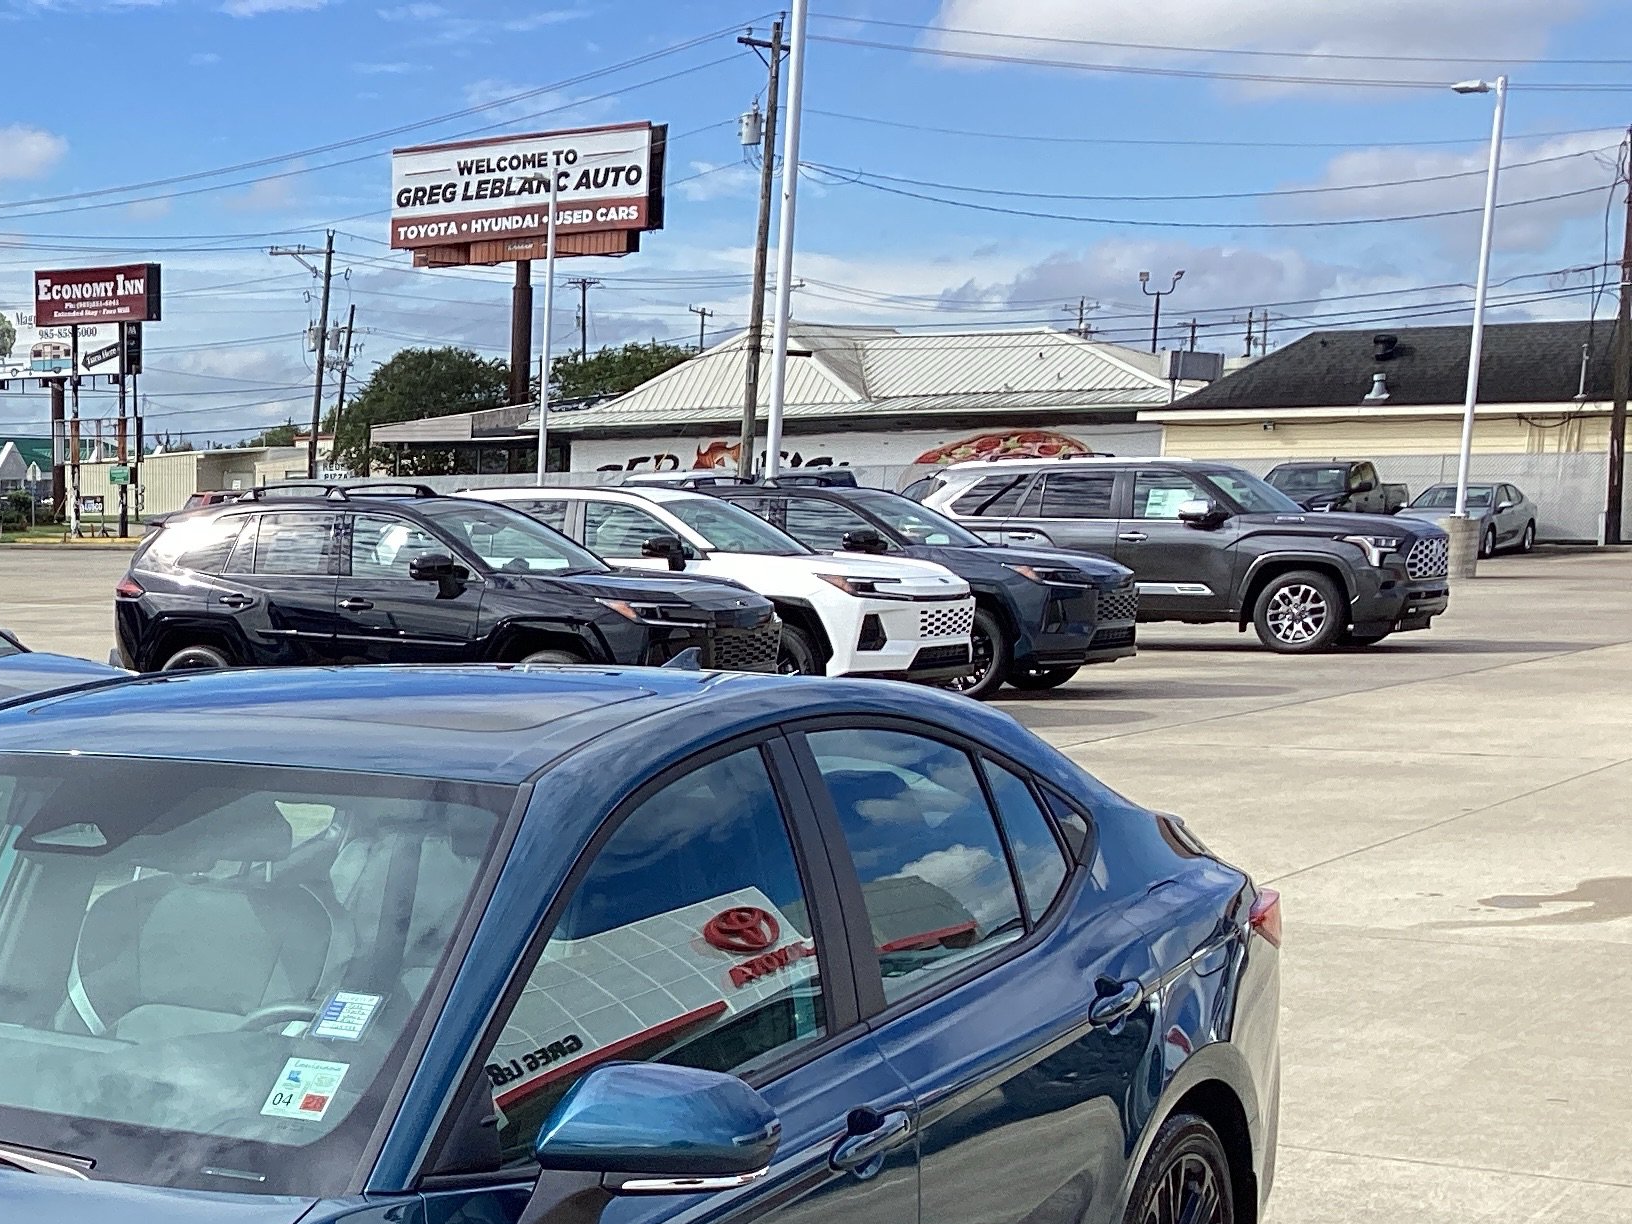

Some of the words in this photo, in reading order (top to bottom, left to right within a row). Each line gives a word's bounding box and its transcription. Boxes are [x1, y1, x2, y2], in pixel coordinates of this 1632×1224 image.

[457, 153, 548, 177] WELCOME
[552, 149, 578, 166] TO
[396, 182, 458, 208] GREG
[461, 171, 570, 201] LEBLANC
[573, 164, 643, 191] AUTO
[397, 221, 458, 240] TOYOTA
[471, 213, 539, 233] HYUNDAI
[555, 207, 594, 226] USED
[596, 205, 639, 222] CARS
[272, 1092, 294, 1107] 04
